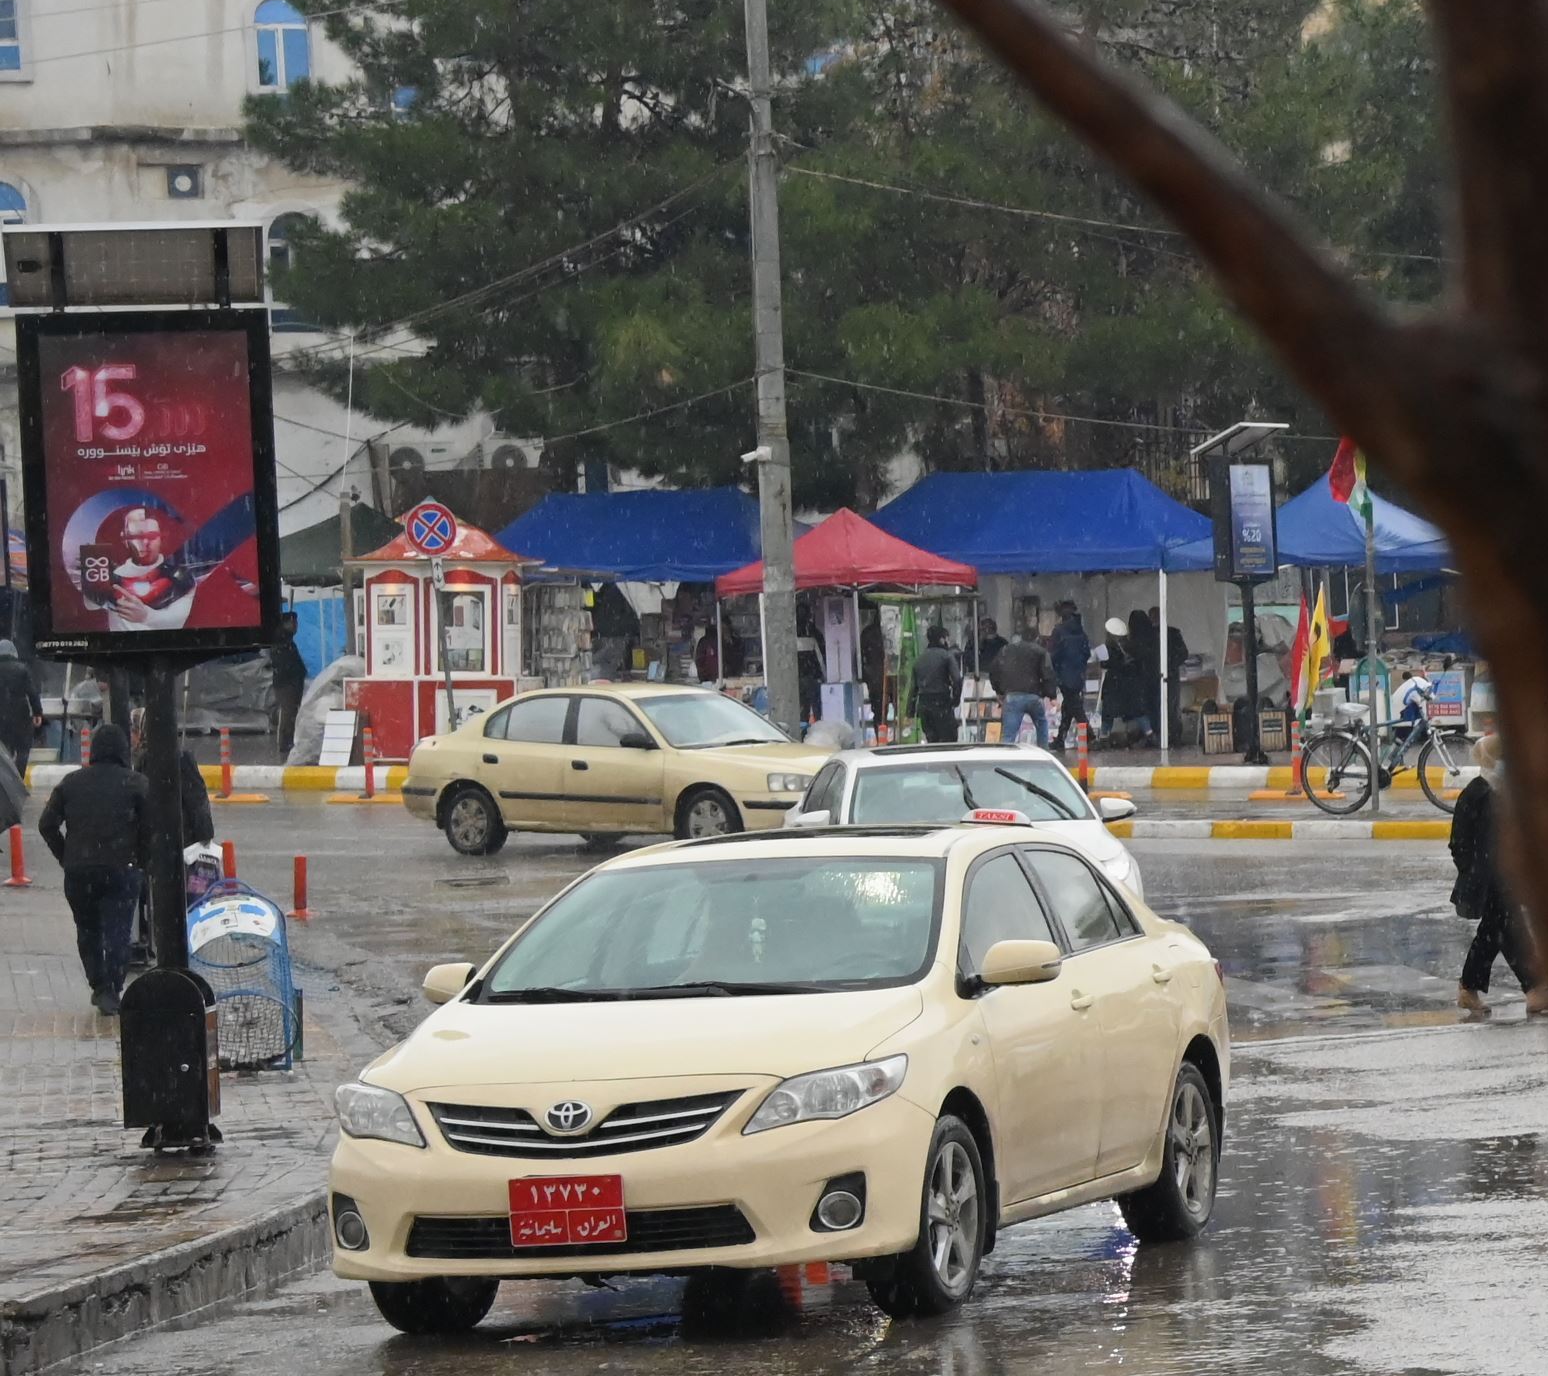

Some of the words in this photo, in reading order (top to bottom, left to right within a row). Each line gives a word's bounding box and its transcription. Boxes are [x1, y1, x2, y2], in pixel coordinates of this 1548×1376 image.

[86, 568, 110, 582] GB
[530, 1183, 600, 1207] ١٣٧٣٠
[576, 1214, 616, 1237] العراق
